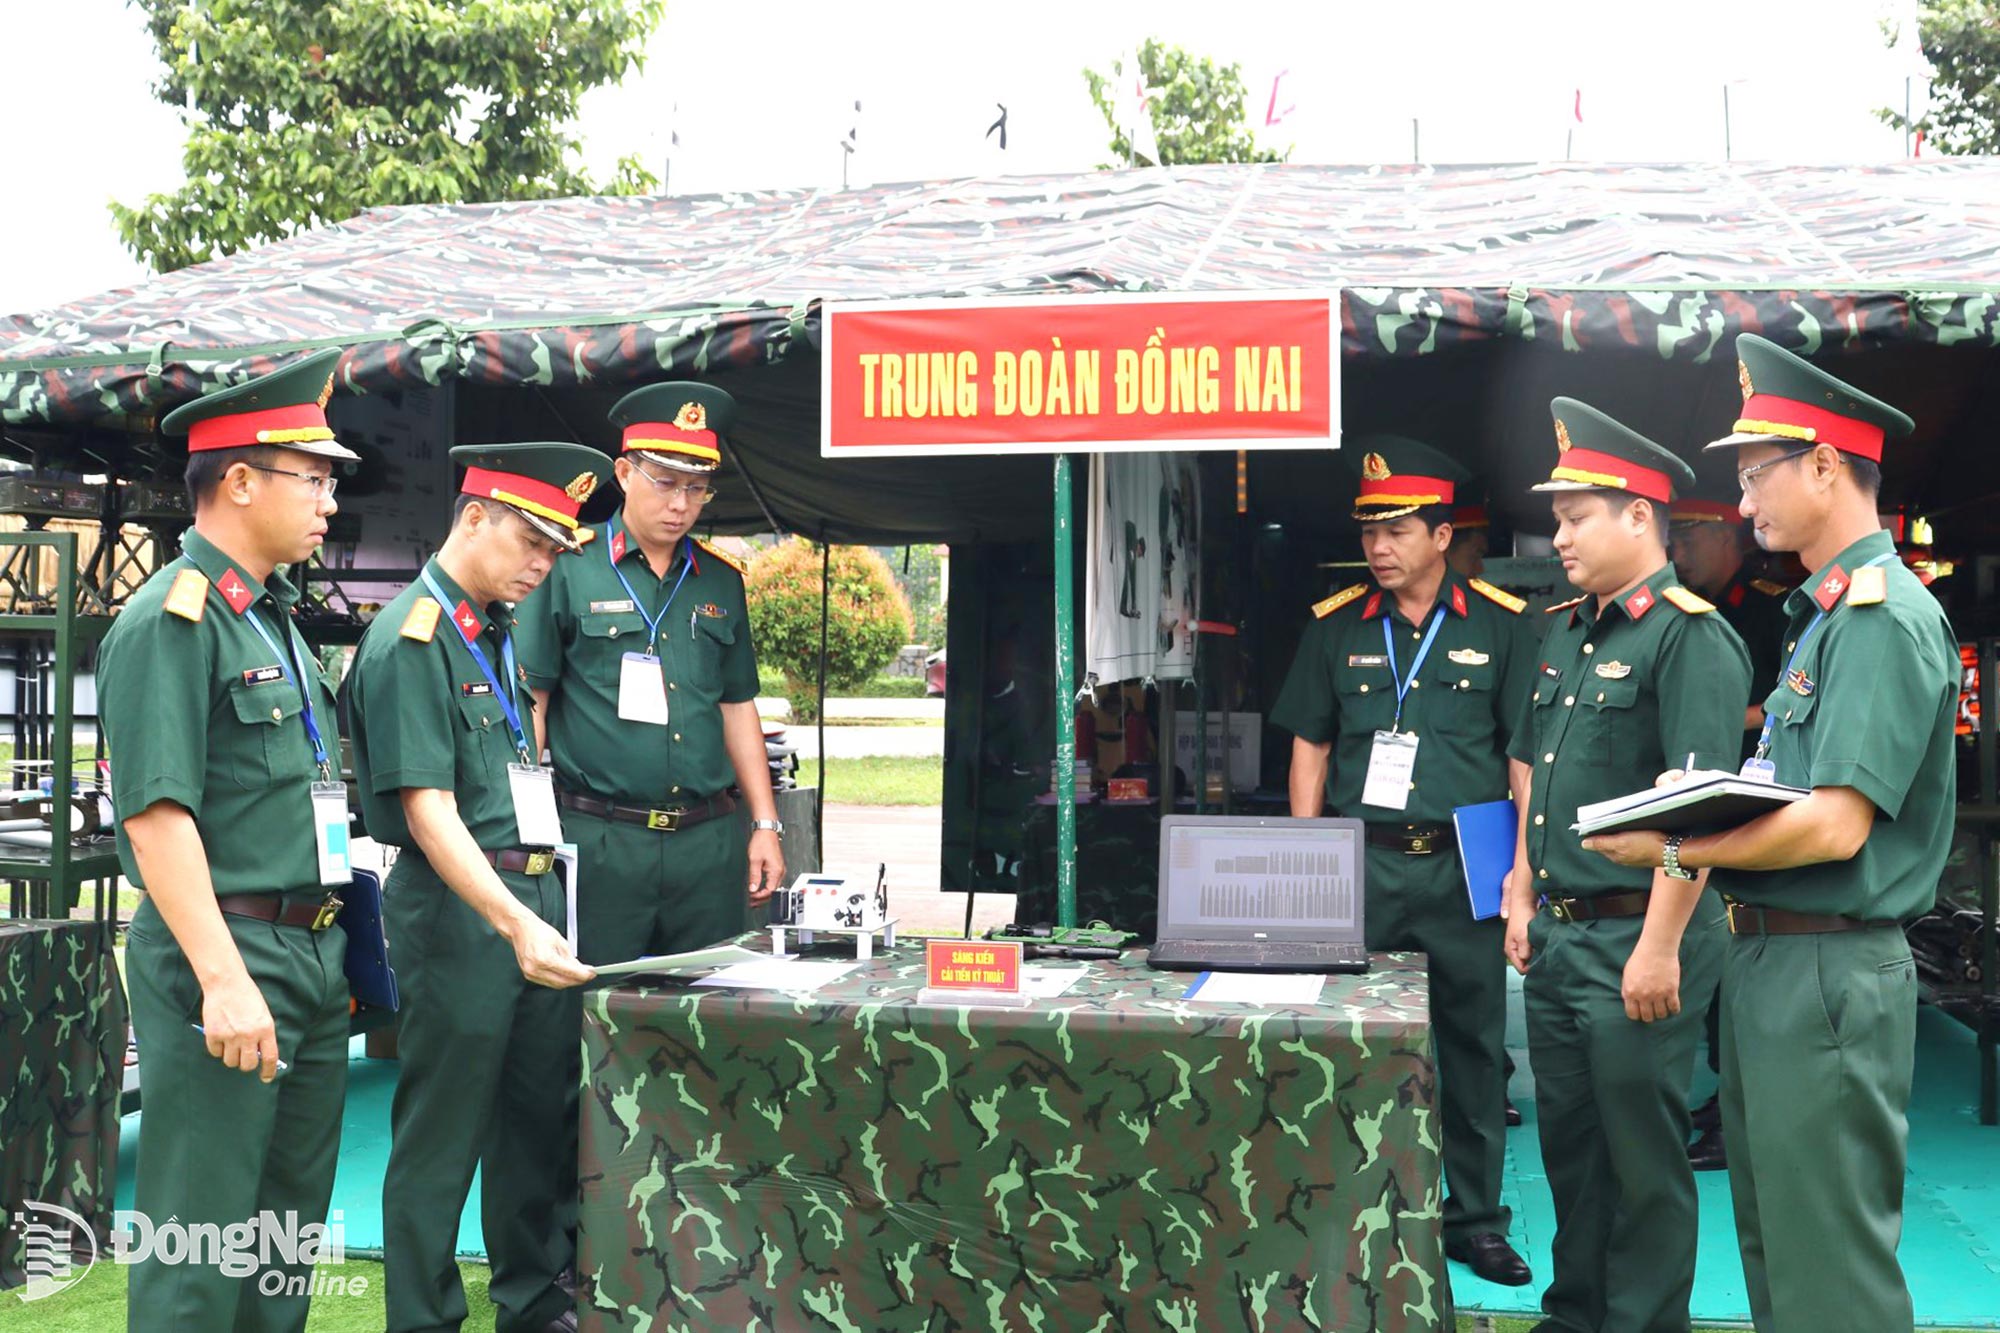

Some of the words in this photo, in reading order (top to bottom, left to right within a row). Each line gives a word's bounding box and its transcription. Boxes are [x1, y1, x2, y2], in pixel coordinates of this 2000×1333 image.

[859, 351, 978, 418] TRUNG
[993, 336, 1100, 416] ĐOÀN
[1115, 327, 1220, 414] ĐỒNG
[1234, 345, 1301, 412] NAI
[952, 949, 974, 964] SÁNG
[975, 949, 994, 965] KIẾN
[954, 966, 971, 982] TIẾN
[983, 969, 1005, 986] THUẬT
